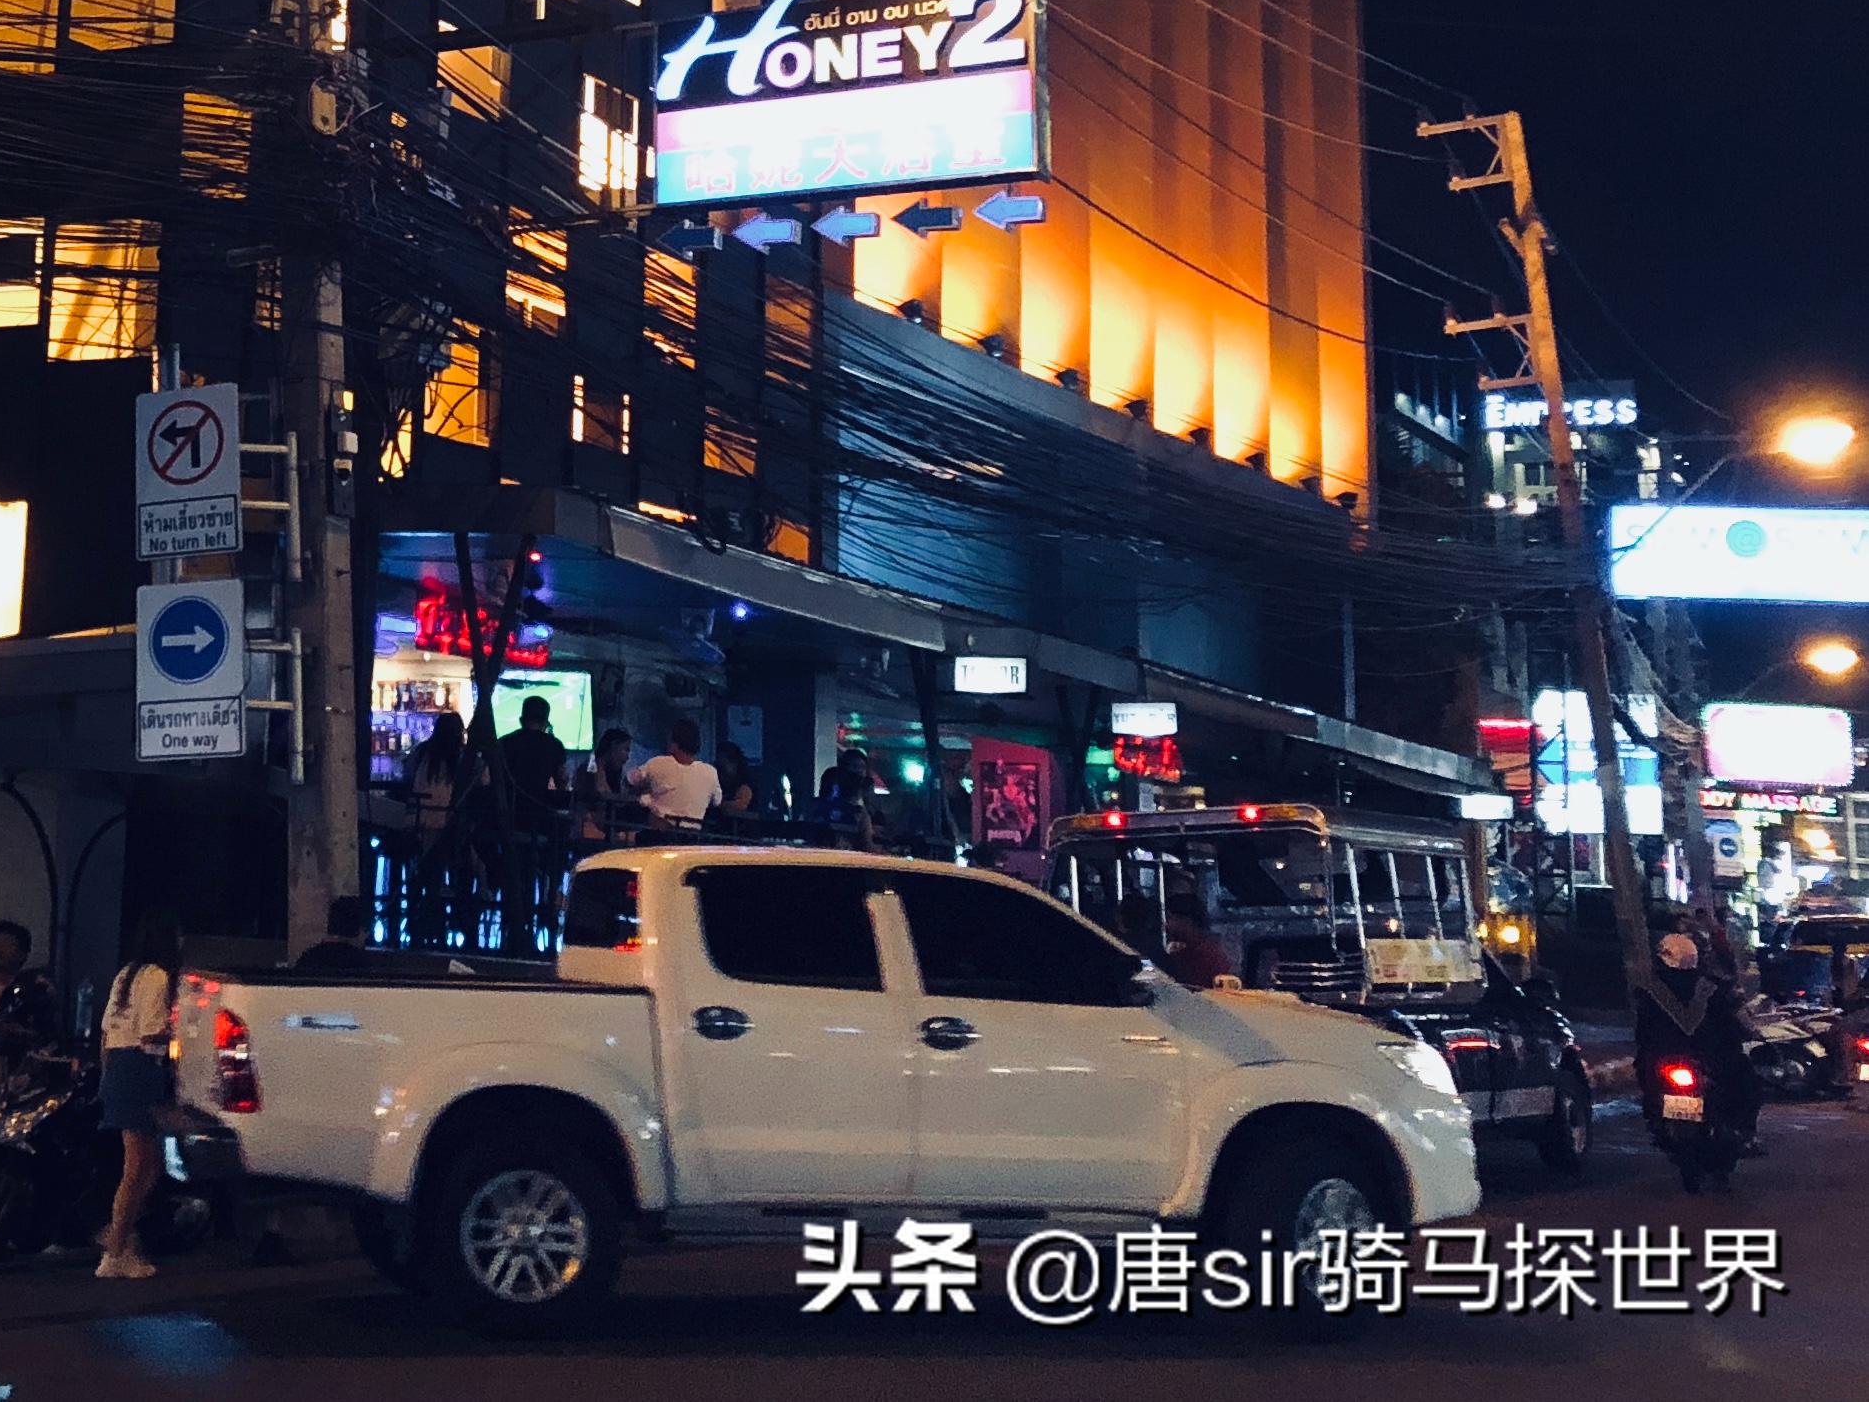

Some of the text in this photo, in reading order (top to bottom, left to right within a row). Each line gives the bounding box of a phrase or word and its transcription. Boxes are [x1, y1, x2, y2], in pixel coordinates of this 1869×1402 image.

[1485, 394, 1638, 428] EMPESS
[143, 503, 233, 534] ห้ามเลี้ยวซ้าย
[150, 531, 227, 552] No turn left
[141, 703, 238, 730] เดินรถทางเดียว
[162, 733, 218, 750] One way
